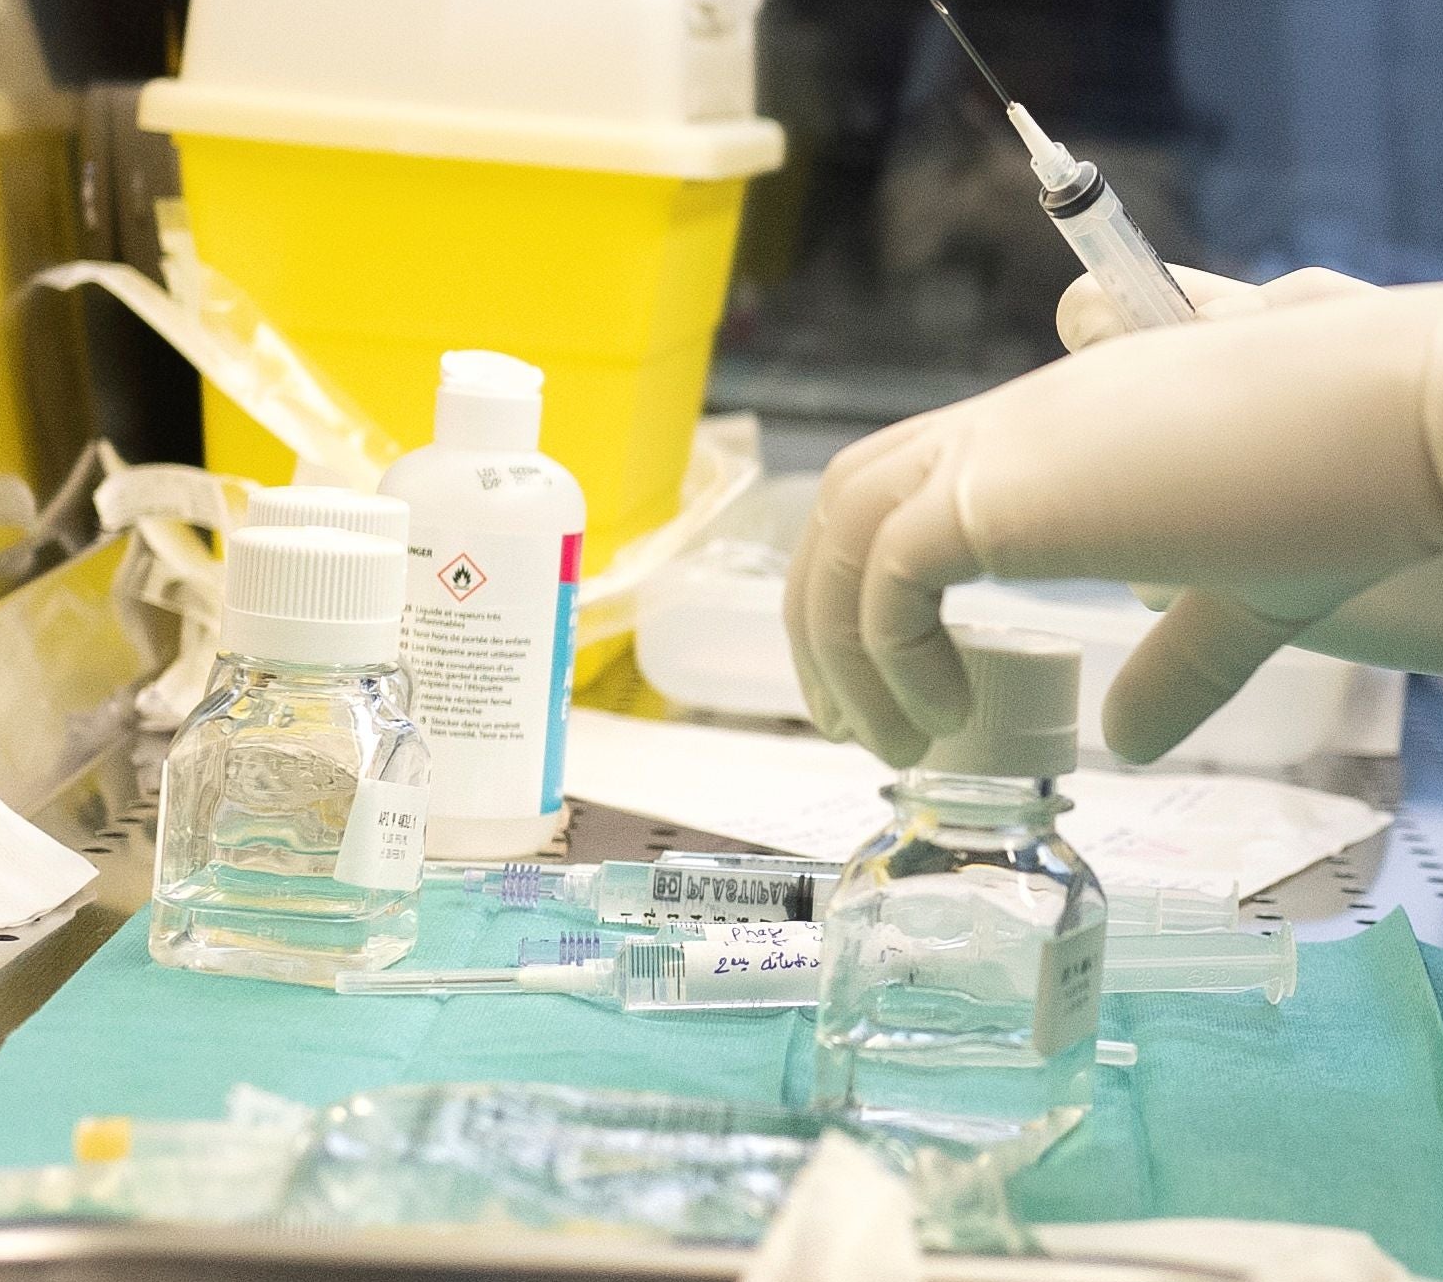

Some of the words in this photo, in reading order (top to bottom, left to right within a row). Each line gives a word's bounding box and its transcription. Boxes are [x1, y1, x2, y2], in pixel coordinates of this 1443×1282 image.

[415, 605, 442, 618] Liquide
[454, 610, 485, 620] vapeurs
[415, 618, 465, 629] inflammables
[413, 628, 430, 637] Tenir
[432, 630, 447, 639] hors
[450, 632, 460, 641] de
[462, 634, 487, 644] portée
[490, 636, 503, 645] des
[505, 637, 531, 646] enfants
[412, 643, 424, 651] Lire
[490, 650, 526, 658] utilisation
[435, 659, 444, 668] de
[446, 660, 494, 671] consultation
[497, 663, 513, 672] d'un
[446, 672, 470, 682] garder
[480, 673, 520, 684] disposition
[454, 695, 488, 706] récipient
[491, 695, 512, 705] fermé
[451, 705, 482, 714] étanche
[431, 716, 459, 726] Stocker
[461, 719, 479, 728] dans
[494, 720, 520, 729] endroit
[431, 726, 446, 736] bien
[479, 729, 496, 739] Tenir
[510, 731, 524, 740] frais
[761, 951, 821, 971] dilutio
